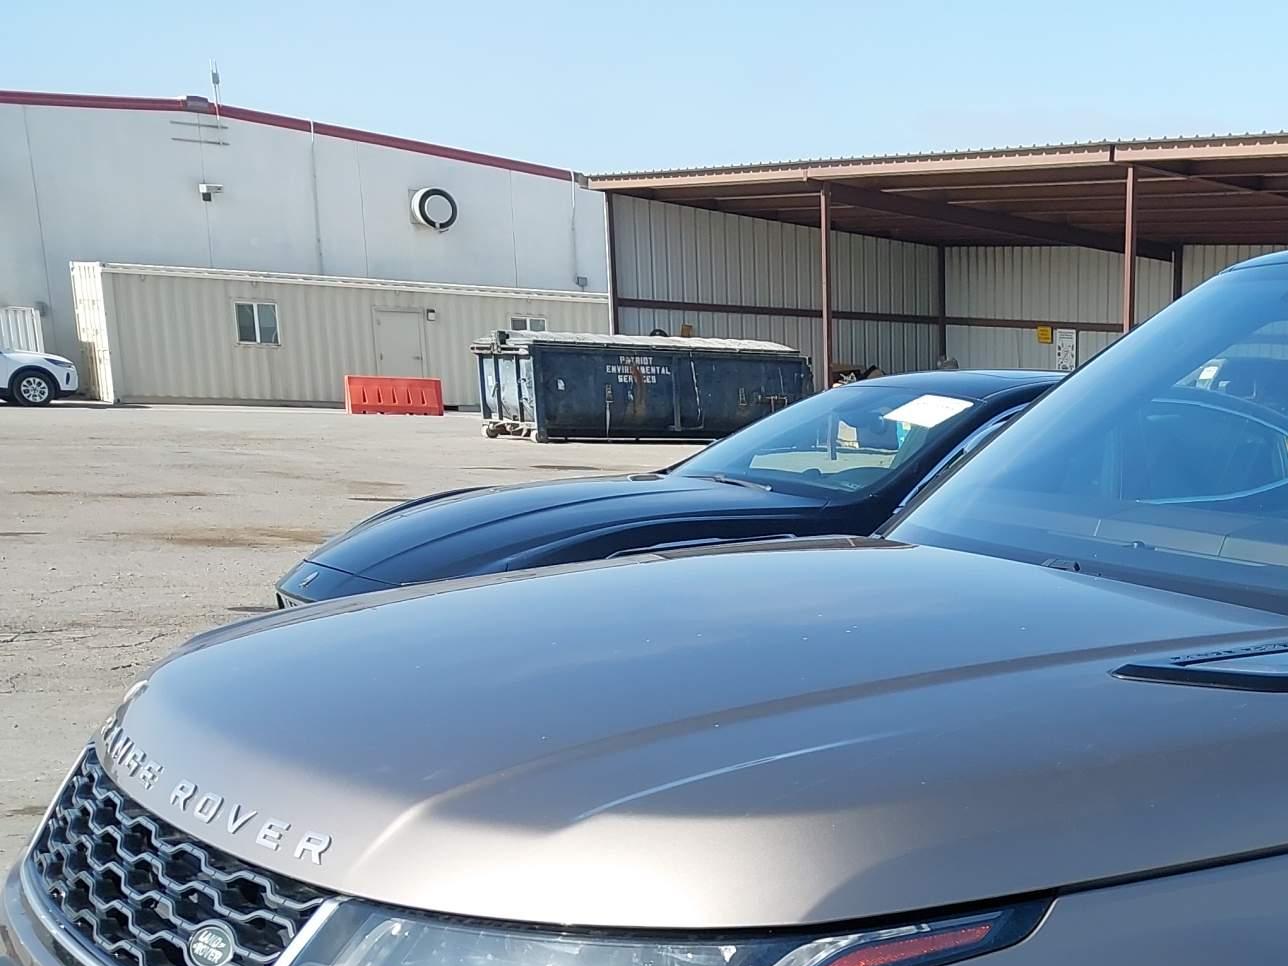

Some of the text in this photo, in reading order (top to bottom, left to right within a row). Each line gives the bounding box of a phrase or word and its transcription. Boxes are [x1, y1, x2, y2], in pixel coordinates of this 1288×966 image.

[619, 356, 653, 365] PATRIOT
[606, 365, 671, 375] ENVIRMENTAL
[617, 375, 657, 383] SERCES
[169, 778, 333, 866] ROVER
[198, 930, 225, 949] LAND
[193, 943, 223, 964] ROVER
